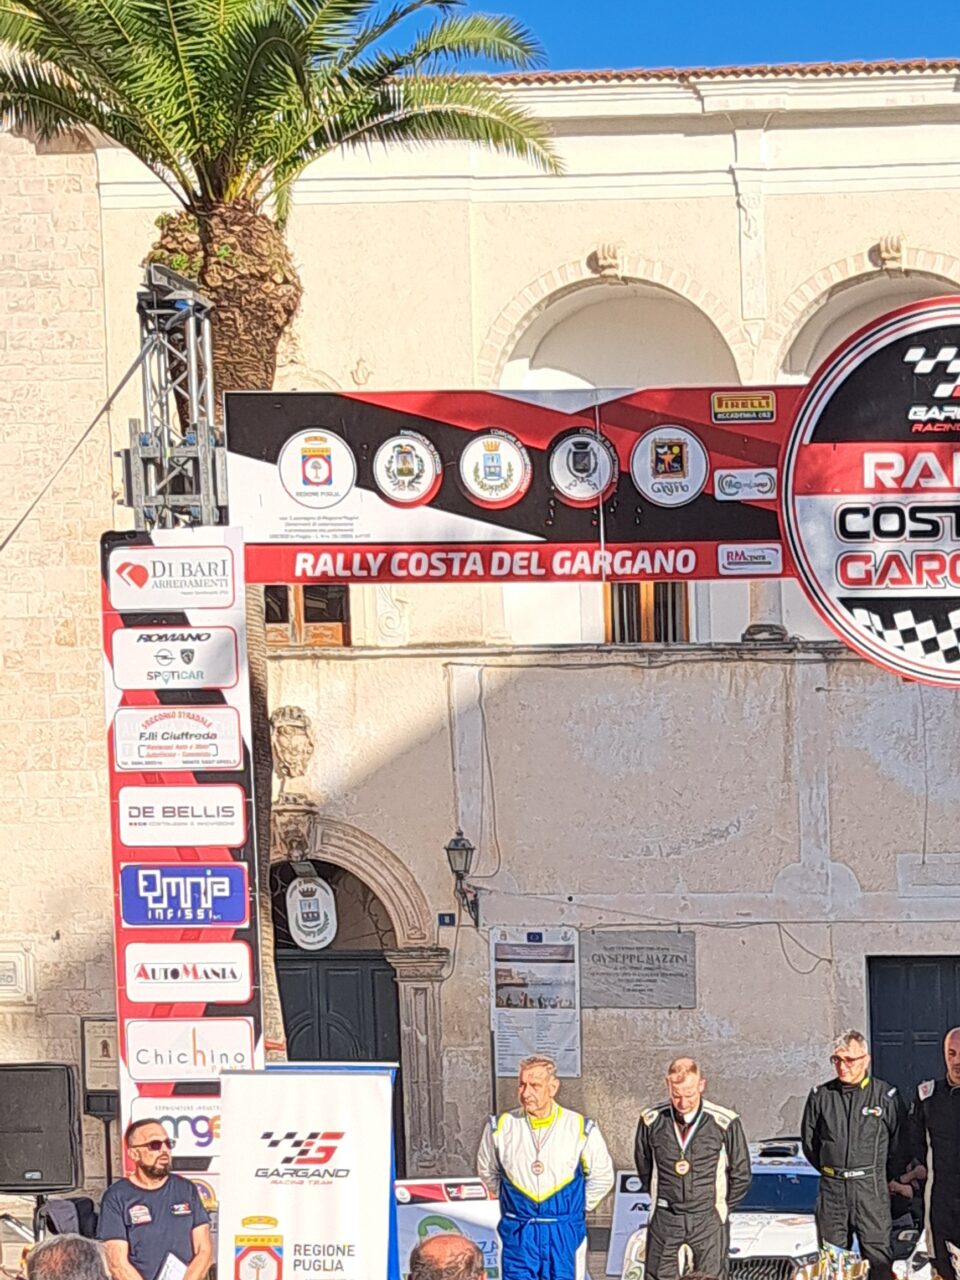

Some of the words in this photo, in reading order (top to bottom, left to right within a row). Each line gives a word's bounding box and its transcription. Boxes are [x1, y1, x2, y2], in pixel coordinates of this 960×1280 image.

[716, 395, 770, 409] PIRELLI
[151, 559, 174, 578] DI
[180, 559, 229, 578] BARI
[294, 552, 386, 577] RALLY
[390, 551, 484, 577] COSTA
[490, 550, 547, 576] DEL
[552, 549, 697, 576] GARGANO
[151, 578, 229, 589] ARREDAMENTI
[136, 632, 212, 643] ROMANO
[161, 731, 218, 741] Ciuffreda
[128, 805, 155, 818] DE
[162, 805, 236, 818] BELLIS
[136, 1026, 245, 1067] Chichino
[254, 1168, 351, 1178] GARGANO
[293, 1243, 356, 1257] REGIONE
[293, 1258, 344, 1272] PUGLIA
